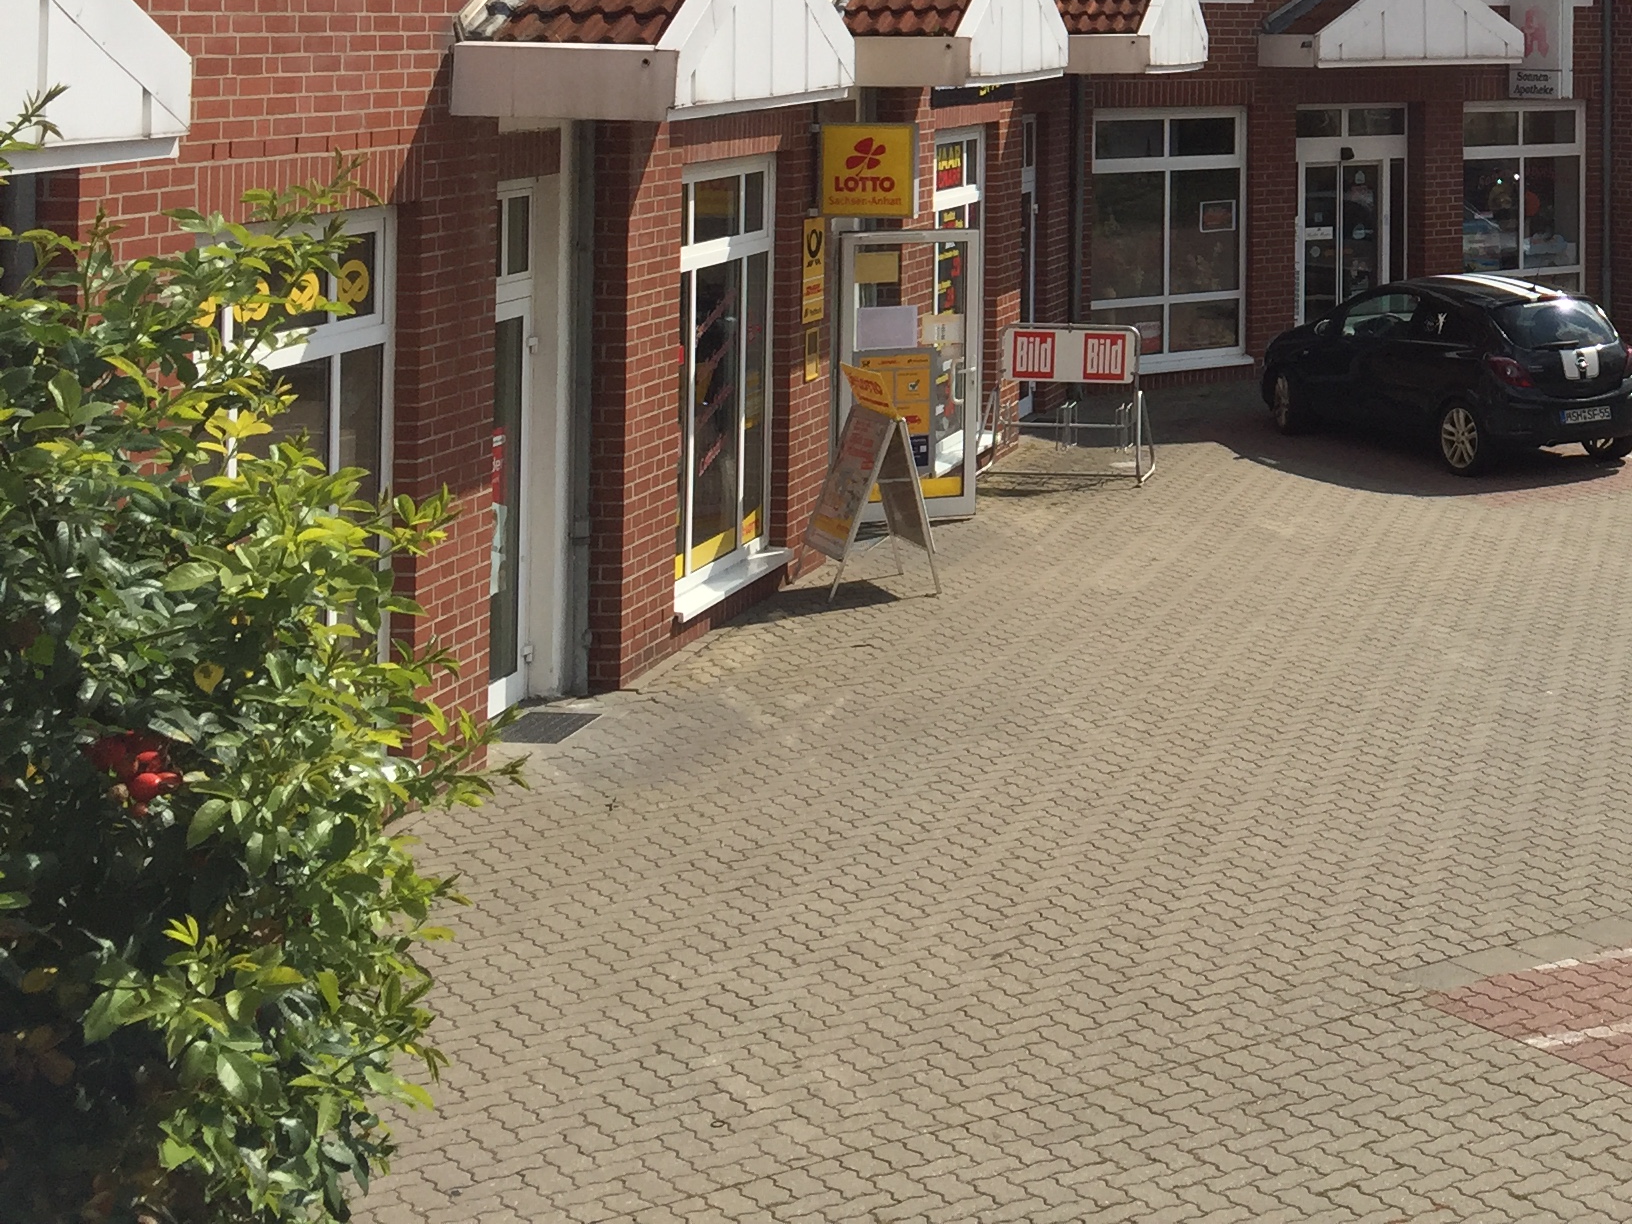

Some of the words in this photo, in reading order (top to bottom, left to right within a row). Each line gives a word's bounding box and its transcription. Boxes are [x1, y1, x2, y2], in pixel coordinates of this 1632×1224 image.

[1513, 84, 1554, 95] Apotheke
[834, 176, 895, 192] LOTTO
[1016, 337, 1052, 372] Bild
[1086, 338, 1122, 374] Bild
